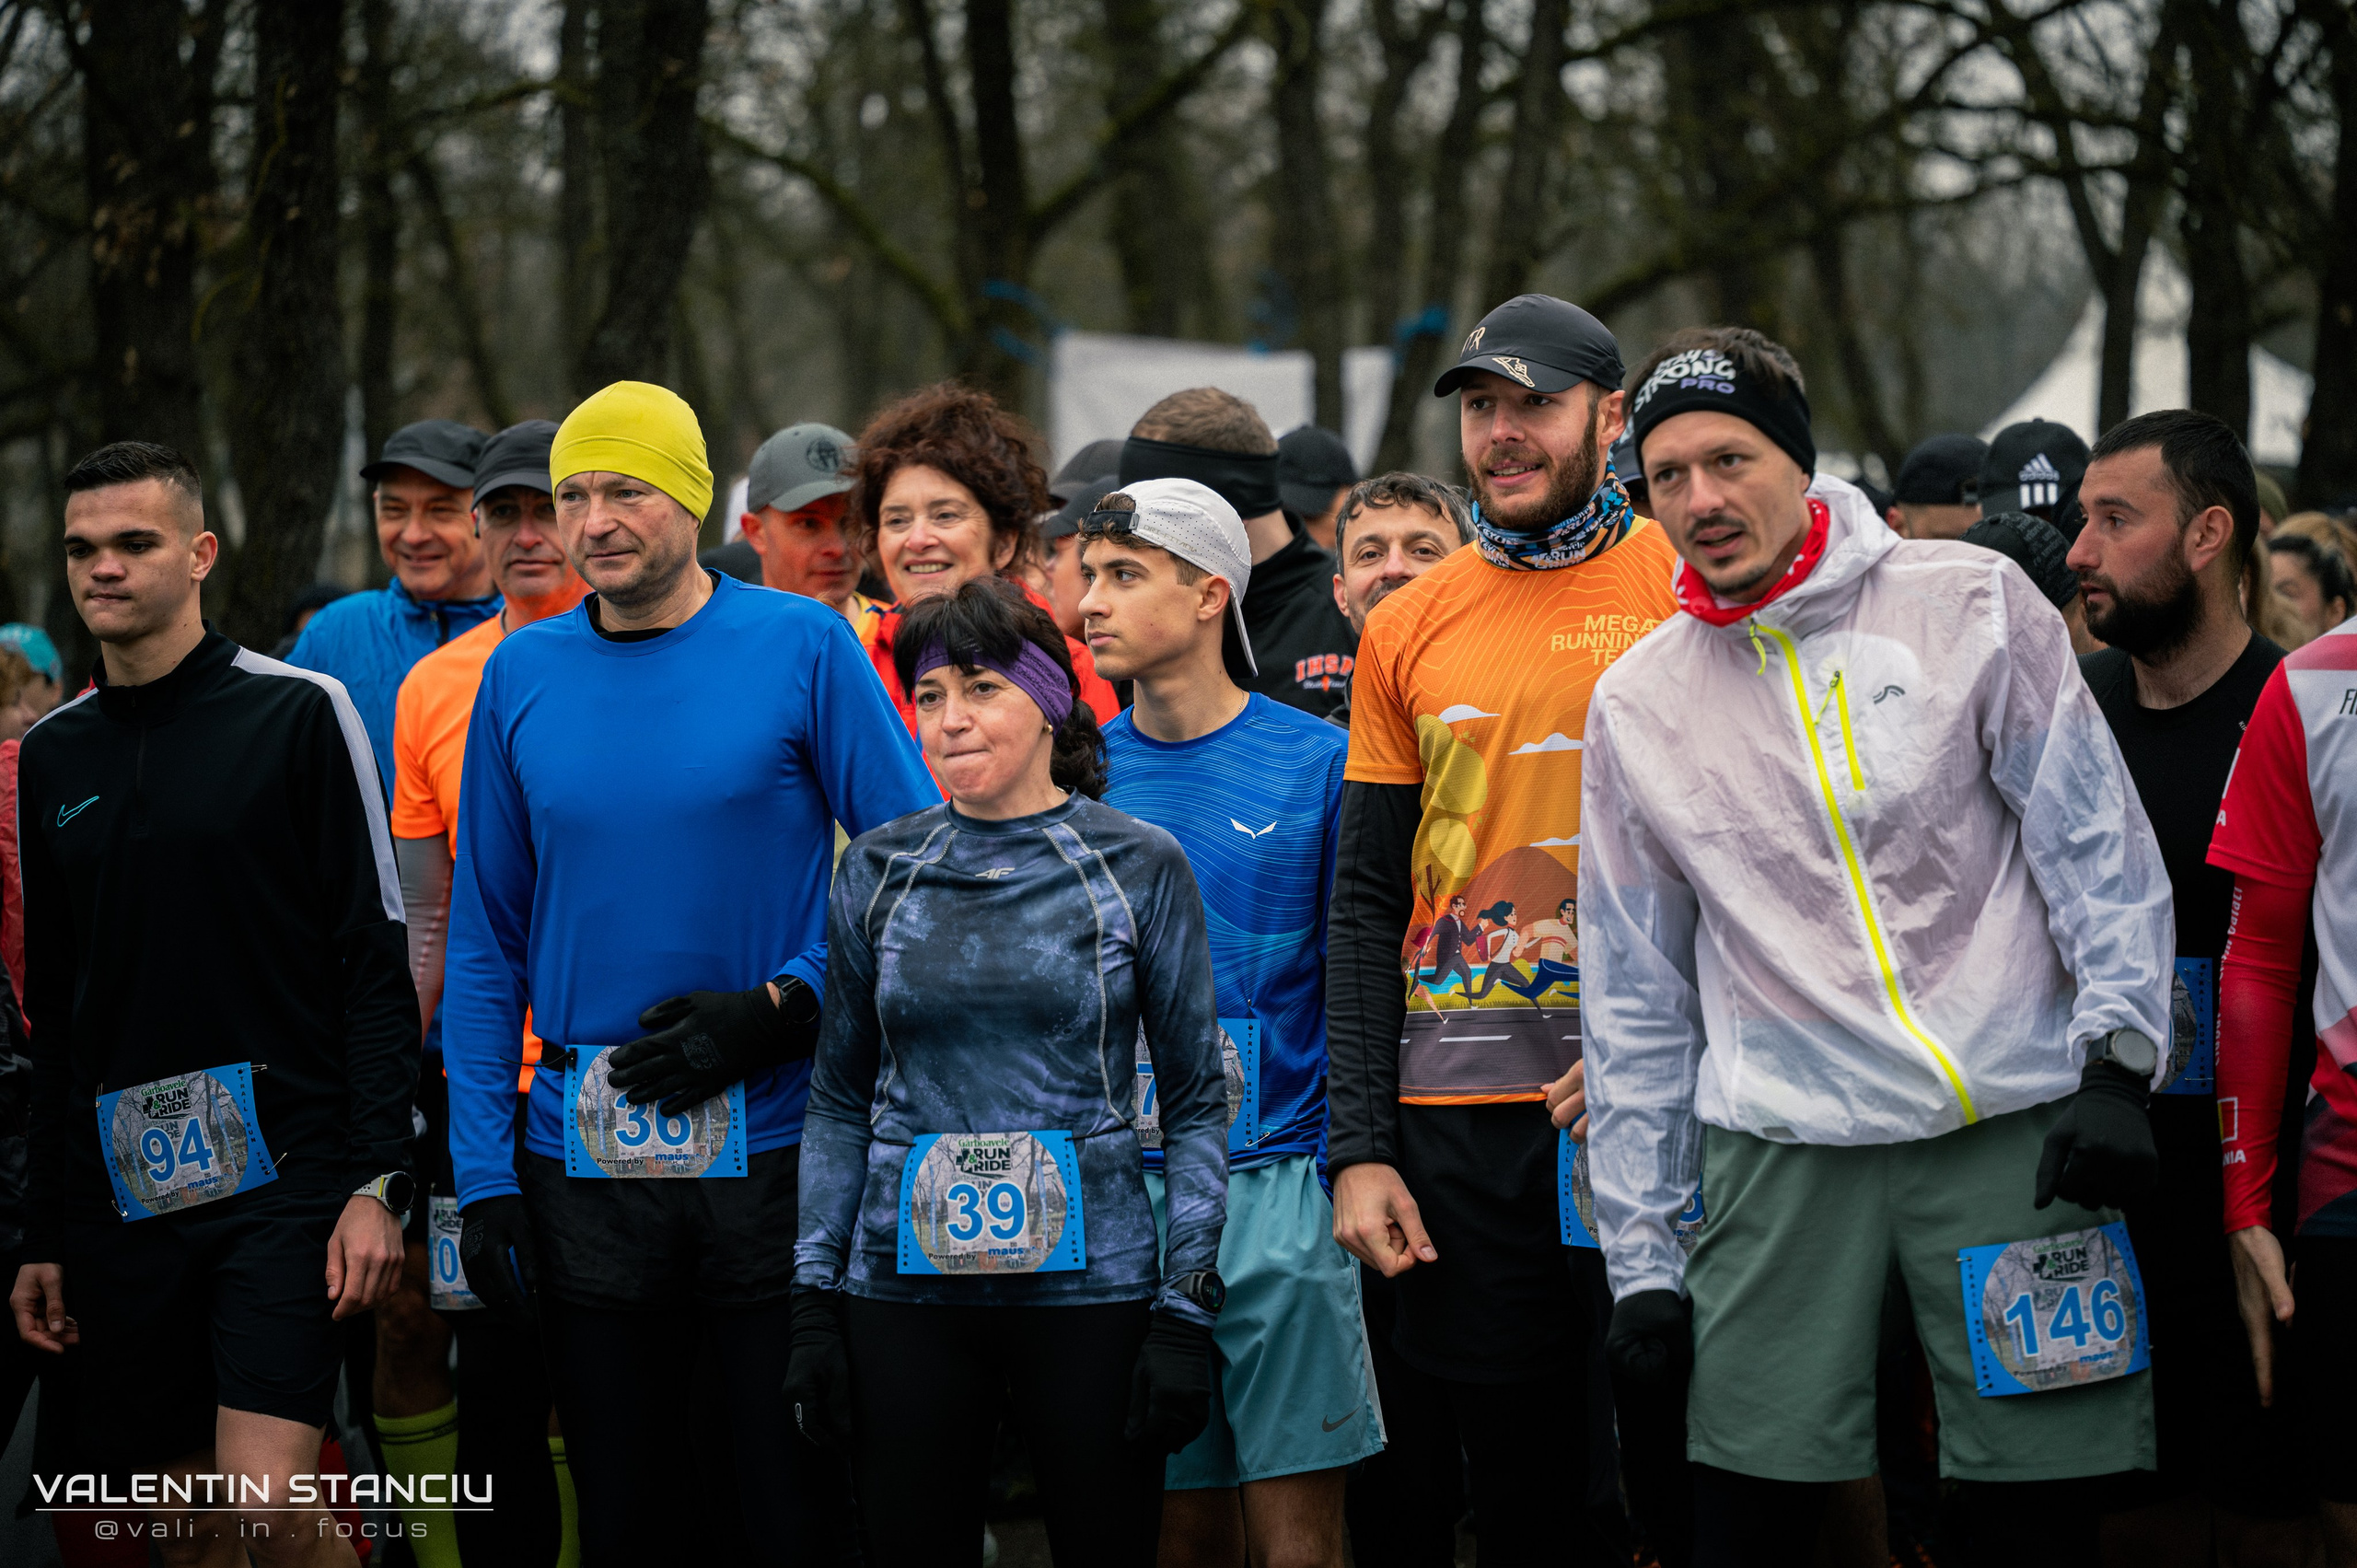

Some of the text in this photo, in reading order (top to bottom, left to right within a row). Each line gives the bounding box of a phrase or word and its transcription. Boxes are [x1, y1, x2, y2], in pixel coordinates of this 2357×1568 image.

[1634, 359, 1736, 413] STRONG
[1680, 377, 1736, 394] PRO
[2018, 470, 2060, 482] adidas
[1550, 549, 1585, 561] RUN
[1585, 614, 1657, 633] MEGA
[1550, 632, 1640, 652] RUNNIN
[1591, 649, 1619, 666] TE
[975, 867, 1016, 879] 4F
[154, 1099, 161, 1110] &
[155, 1089, 190, 1105] RUN
[159, 1098, 192, 1116] RIDE
[238, 1076, 268, 1171] TRAIL RUN 7KM
[614, 1091, 693, 1148] 36
[100, 1110, 110, 1147] TRAIL
[110, 1156, 119, 1178] RUN
[140, 1117, 215, 1183] 94
[958, 1138, 1010, 1148] Gârboavele
[655, 1153, 689, 1161] maus
[969, 1154, 977, 1163] &
[974, 1147, 1011, 1159] RUN
[634, 1157, 644, 1166] by
[974, 1159, 1011, 1171] RIDE
[1064, 1145, 1073, 1185] TRAIL
[907, 1150, 916, 1190] TRAIL
[188, 1176, 218, 1190] maus
[141, 1190, 180, 1205] Powered by
[946, 1182, 1028, 1241] 39
[967, 1253, 976, 1261] by
[2051, 1247, 2087, 1263] RUN
[2054, 1259, 2090, 1277] RIDE
[2003, 1278, 2125, 1357] 146
[2080, 1351, 2114, 1364] maus
